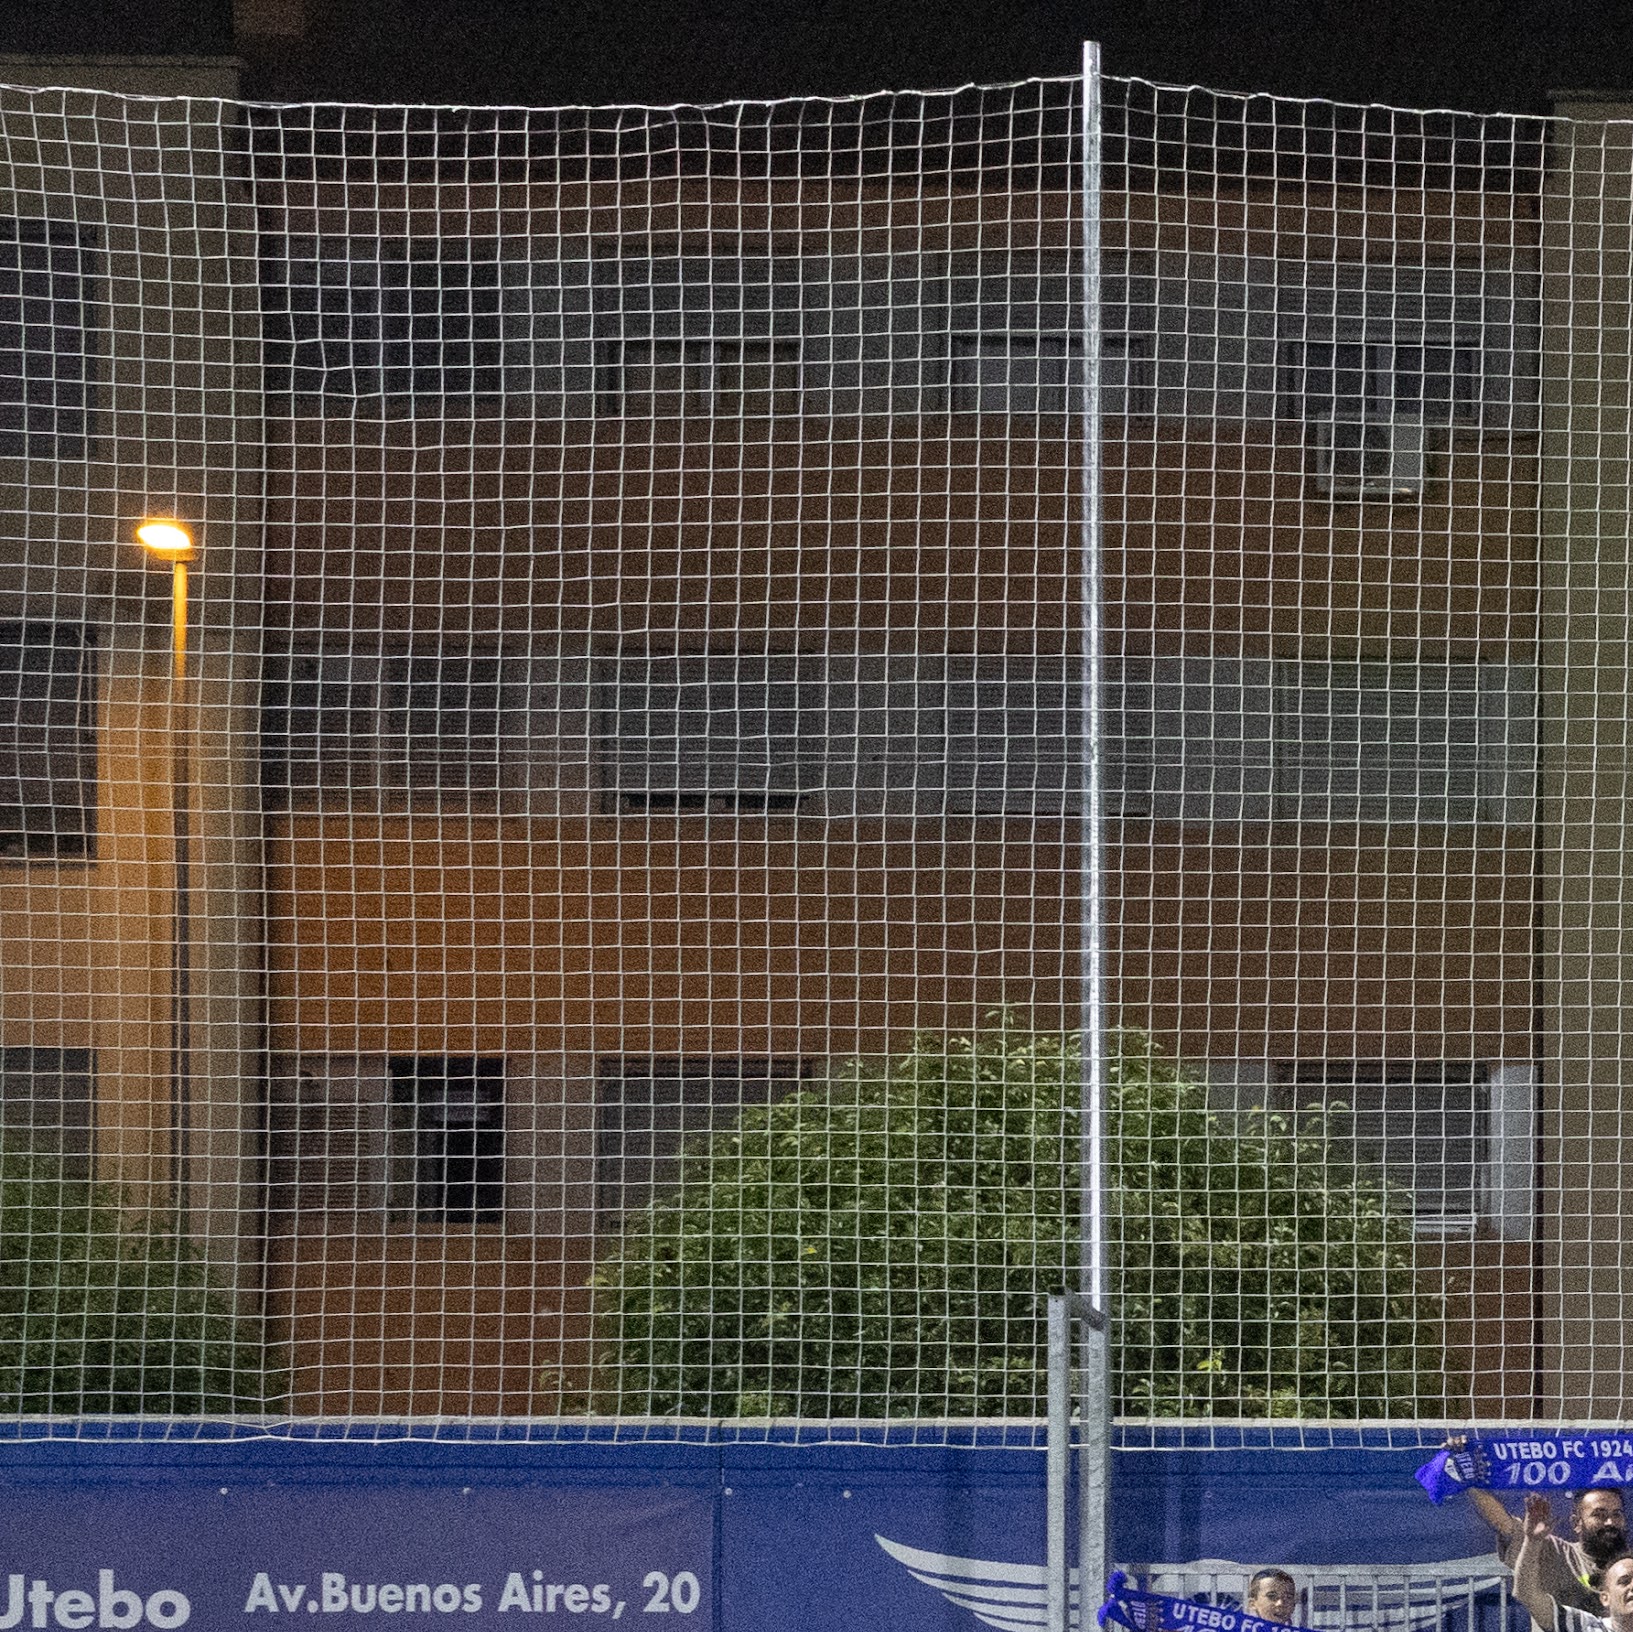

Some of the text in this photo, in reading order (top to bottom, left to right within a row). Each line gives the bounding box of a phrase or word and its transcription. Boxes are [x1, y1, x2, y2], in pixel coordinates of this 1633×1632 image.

[1493, 1441, 1557, 1460] UTEBO
[1563, 1440, 1586, 1458] FC
[1591, 1439, 1633, 1458] 1924
[1503, 1461, 1572, 1485] 100
[244, 1570, 700, 1619] Av.Buenos Aires, 20
[1173, 1602, 1236, 1632] UTEBO
